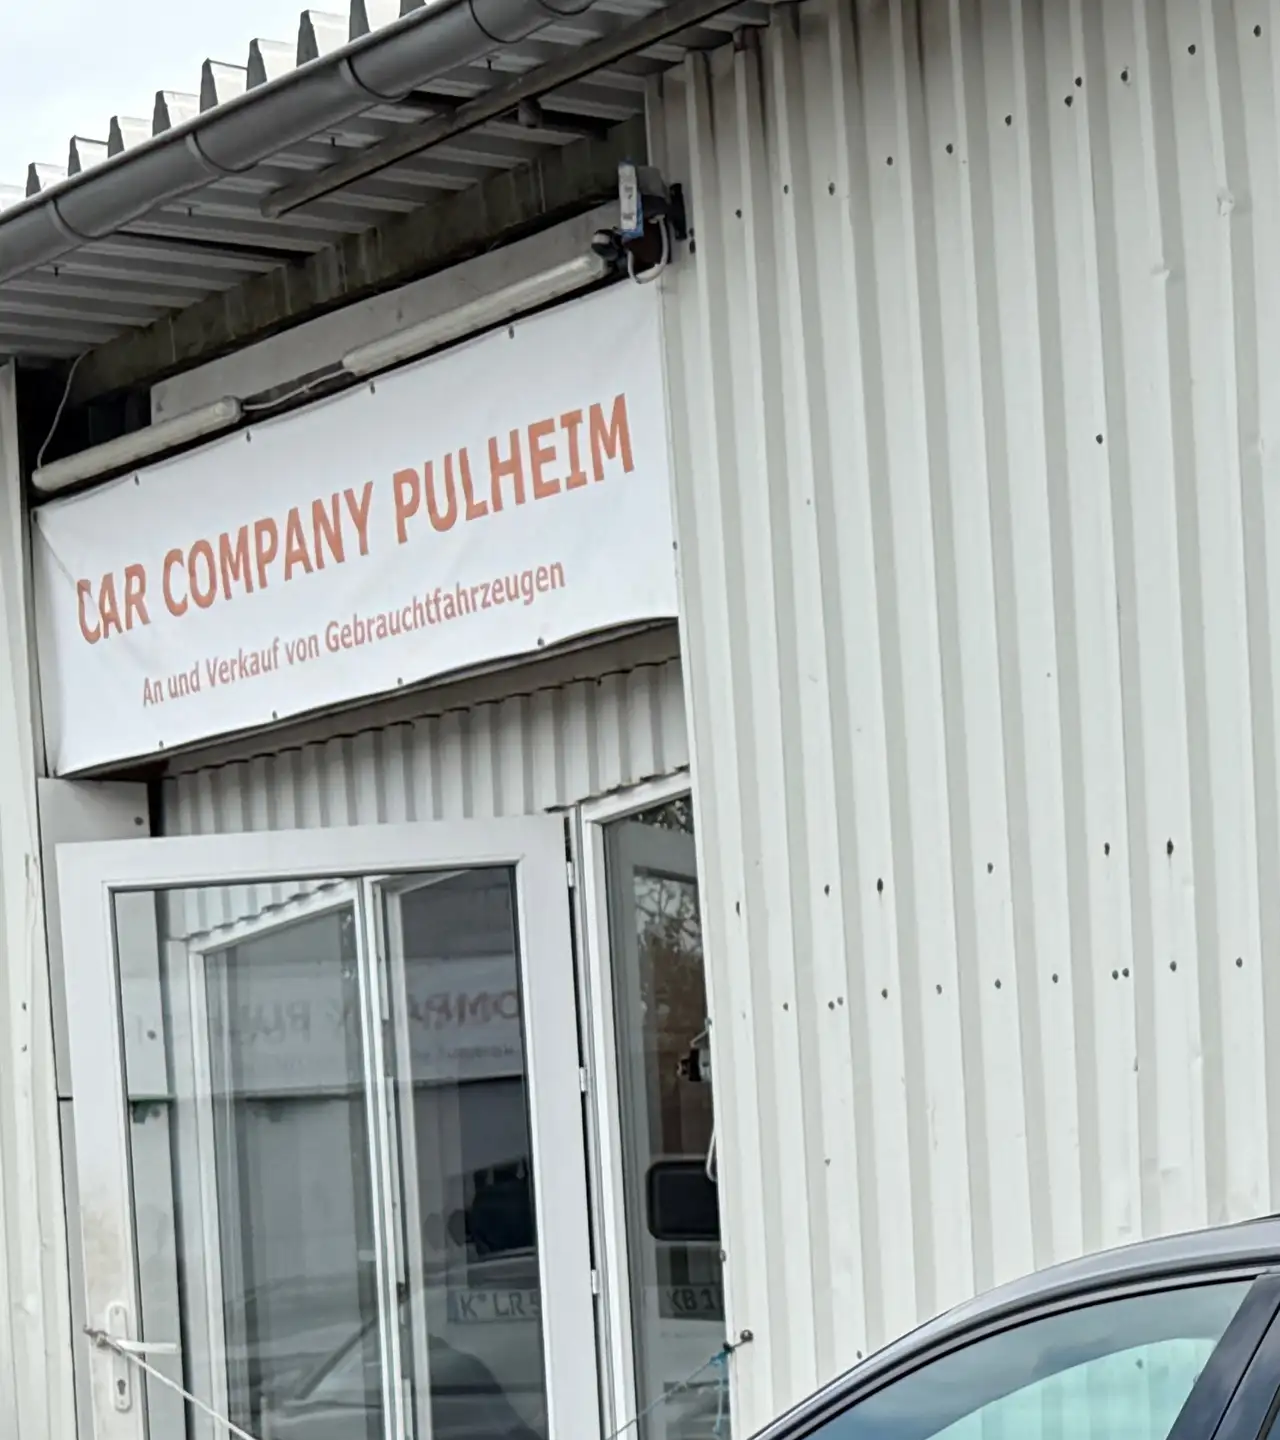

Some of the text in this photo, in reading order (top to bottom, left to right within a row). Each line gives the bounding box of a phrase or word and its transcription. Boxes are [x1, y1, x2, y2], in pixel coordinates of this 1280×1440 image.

[75, 393, 635, 643] CAR COMPANY PULHEIM
[142, 561, 565, 707] An und Verkauf von Gebrauchtfahrzeugen
